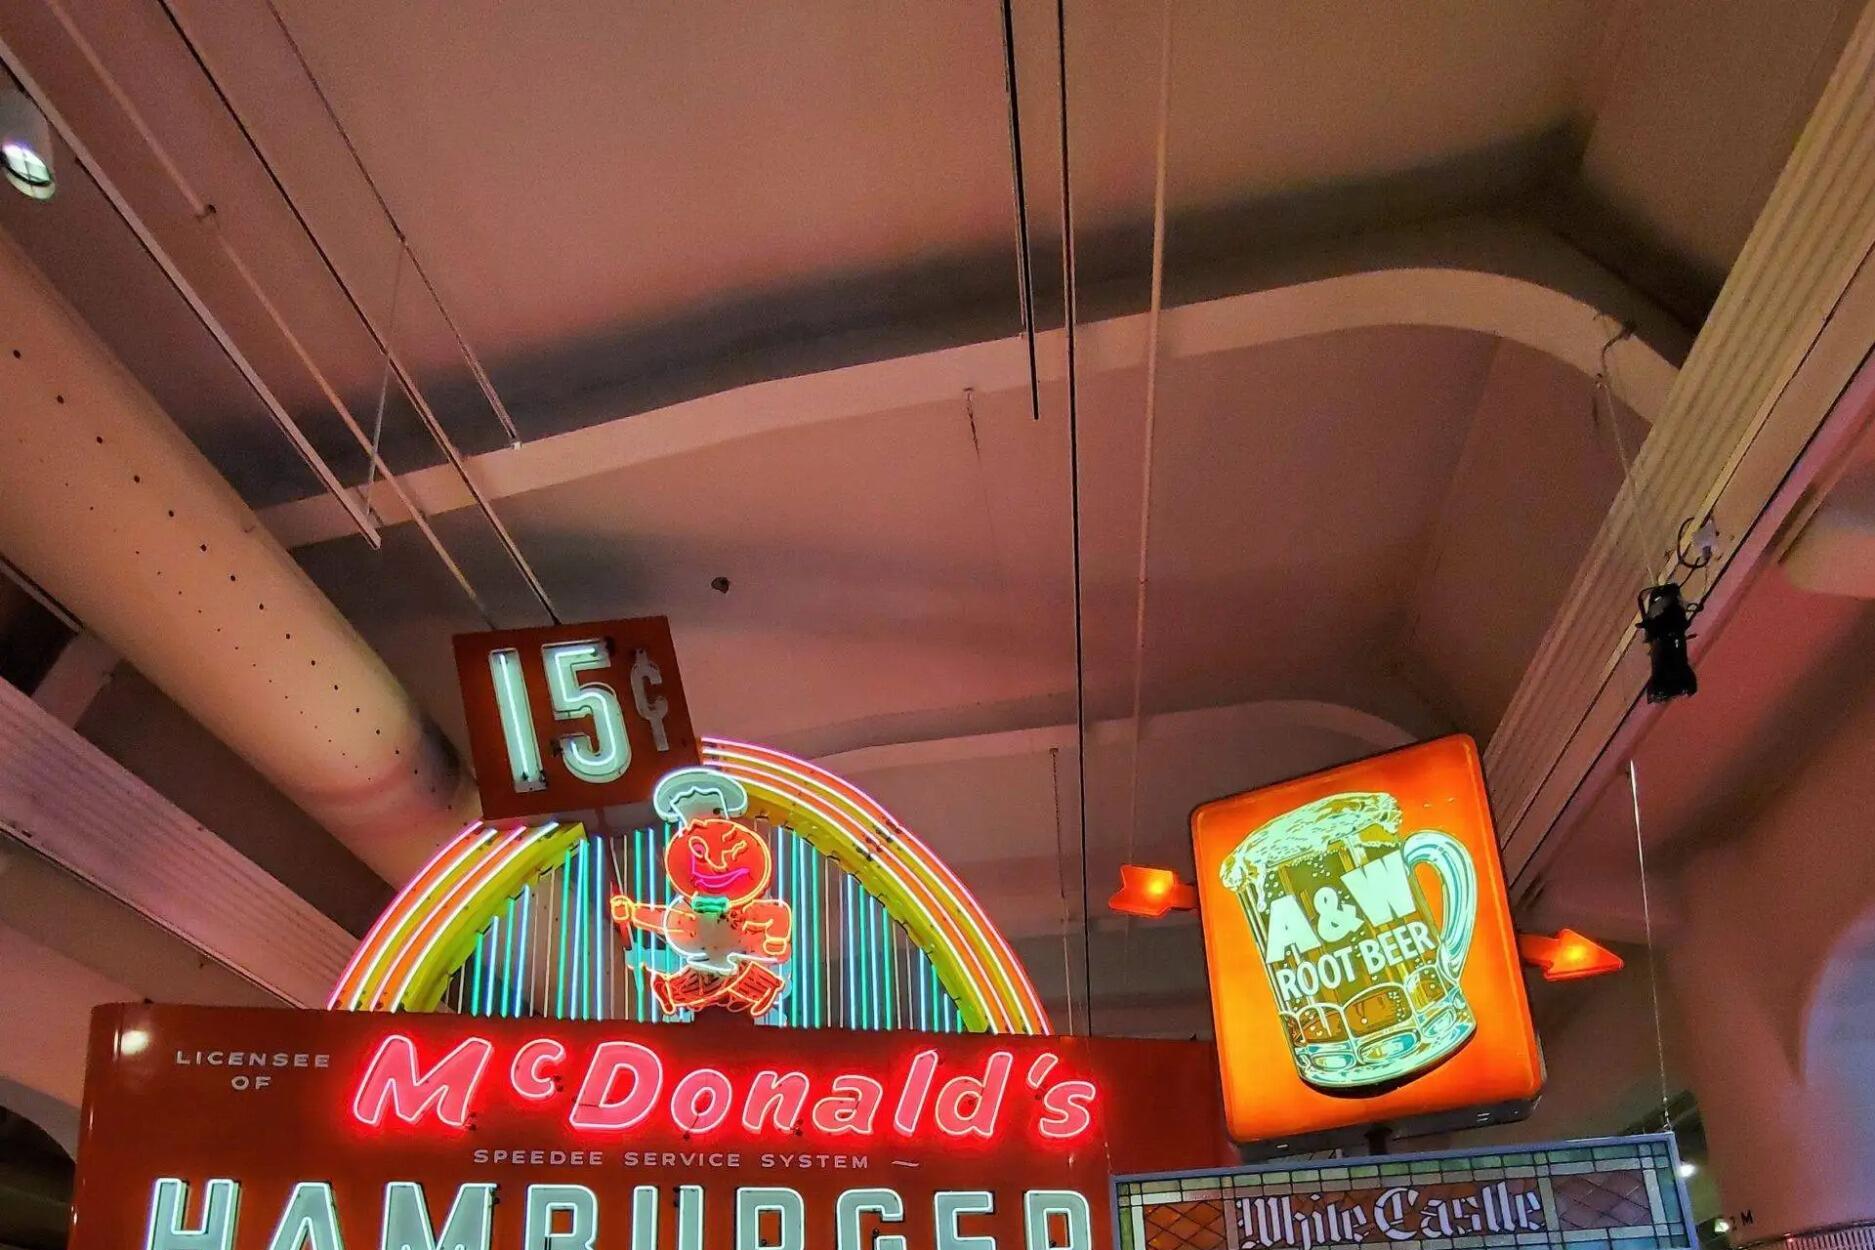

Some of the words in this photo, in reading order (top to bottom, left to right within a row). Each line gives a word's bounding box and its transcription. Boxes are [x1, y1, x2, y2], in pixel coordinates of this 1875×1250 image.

[488, 637, 669, 793] 15¢
[1266, 850, 1416, 964] A&W
[1275, 947, 1356, 1001] ROOT
[1358, 921, 1436, 975] BEER
[176, 1050, 331, 1069] LICENSEE
[231, 1075, 271, 1091] OF
[353, 1034, 1096, 1139] McDonald's
[473, 1149, 604, 1167] SPEEDEE
[624, 1152, 741, 1168] SERVICE
[761, 1153, 869, 1169] SYSTEM
[1373, 1181, 1546, 1241] Castle
